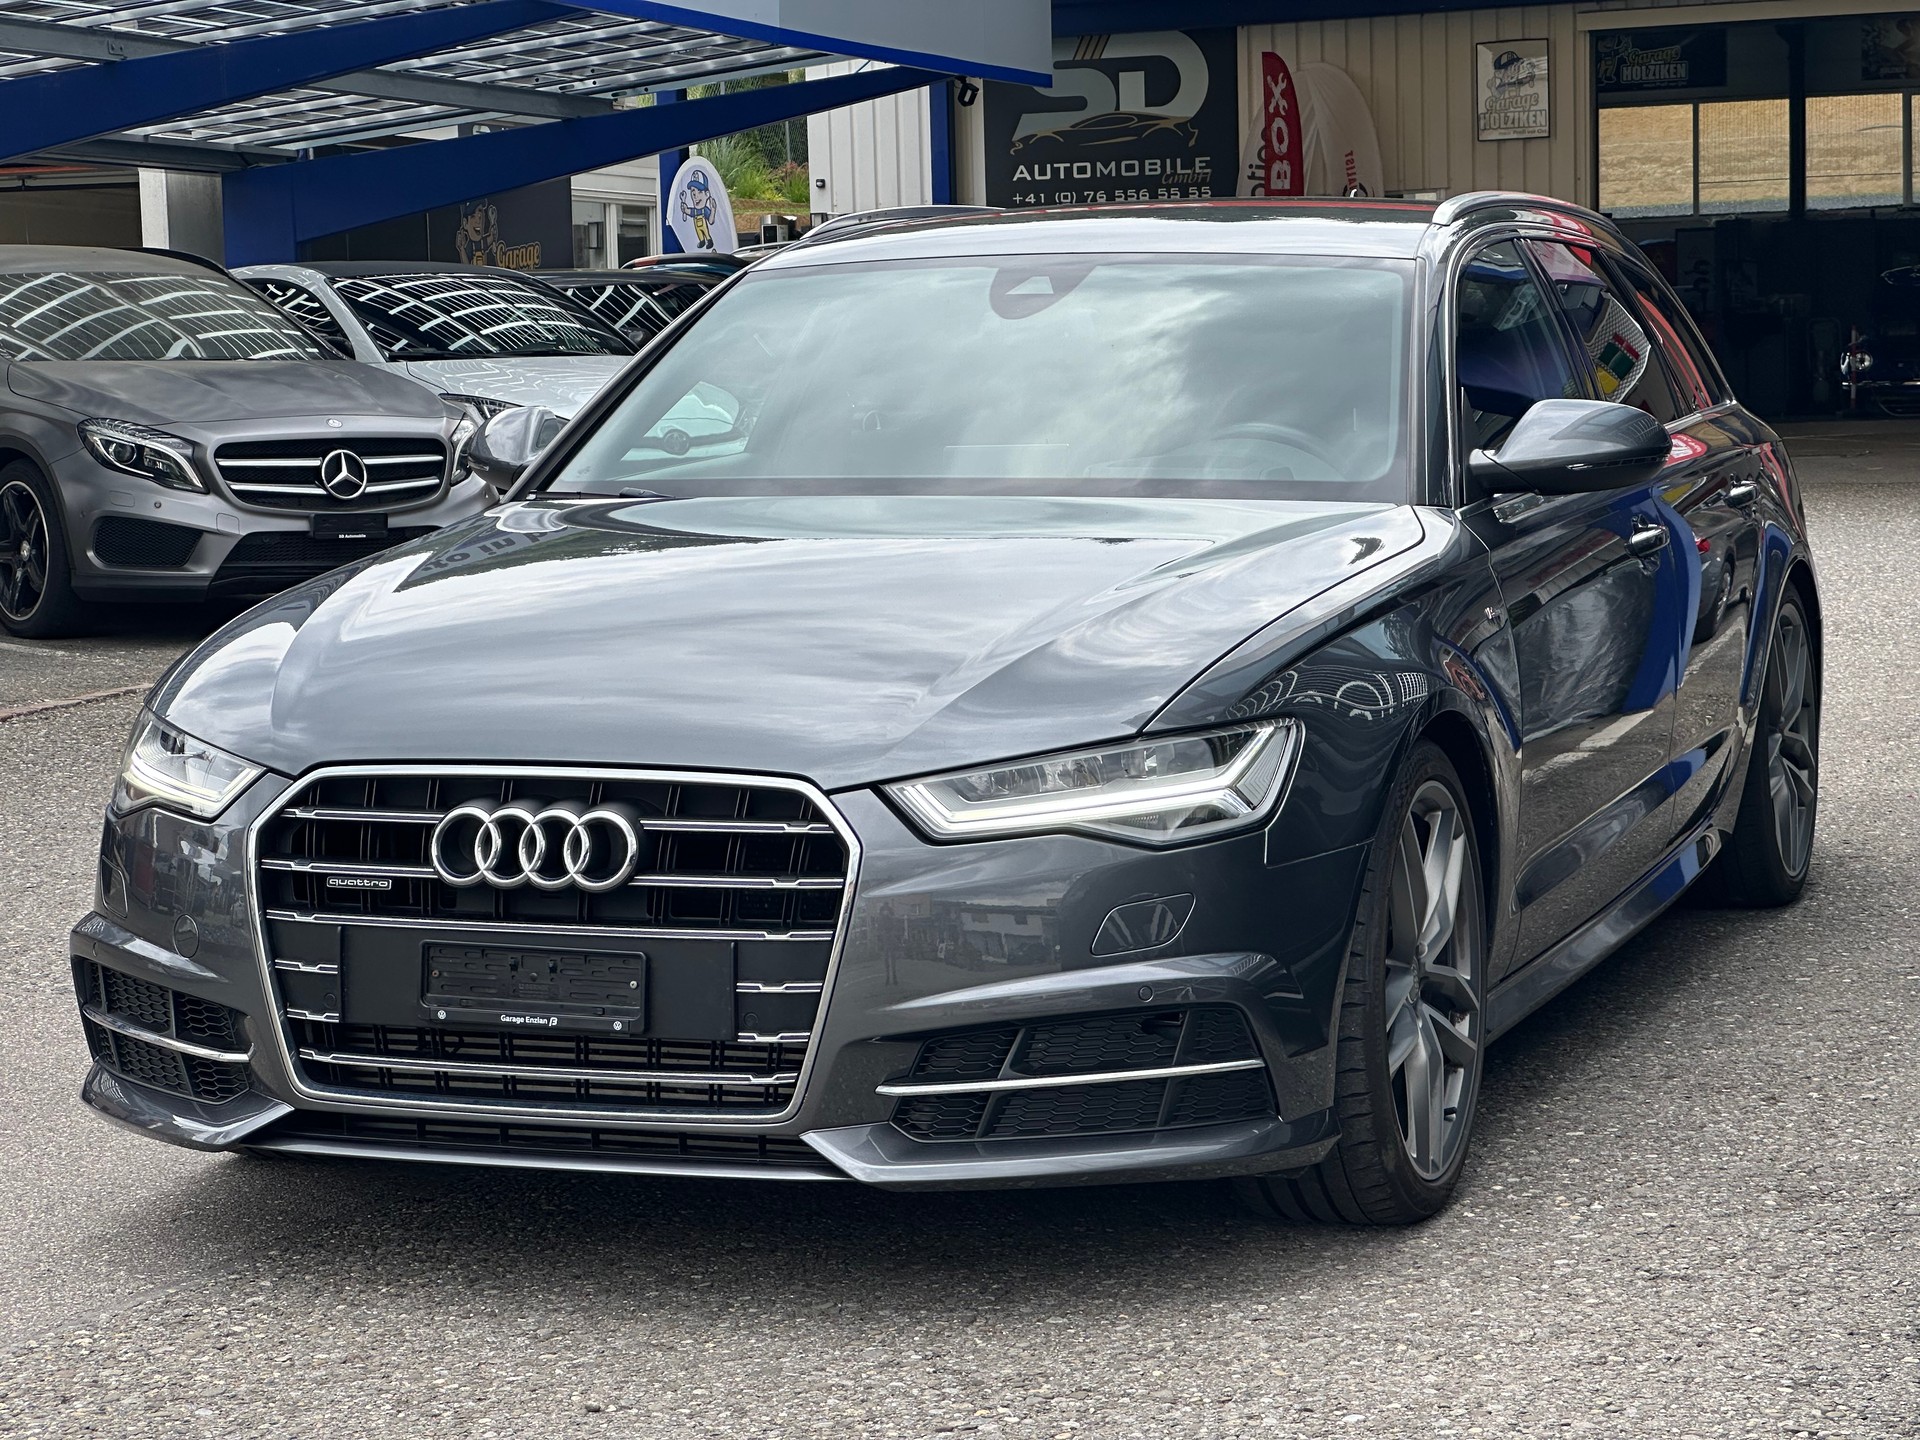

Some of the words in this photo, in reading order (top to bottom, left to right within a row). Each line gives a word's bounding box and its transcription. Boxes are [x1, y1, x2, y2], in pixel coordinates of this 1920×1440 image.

[1622, 63, 1686, 81] HOLZIKEN
[1485, 93, 1539, 111] Garage
[1479, 110, 1547, 131] HOLZIKEN
[1012, 156, 1211, 182] AUTOMOBILE
[1012, 193, 1045, 204] +41
[1084, 190, 1106, 203] 76
[1114, 188, 1150, 201] 556
[1158, 187, 1181, 200] 55
[1188, 186, 1212, 199] 55
[496, 241, 541, 269] Garage
[329, 878, 389, 888] quattro
[500, 1014, 525, 1024] Garage
[525, 1015, 548, 1025] Enzian
